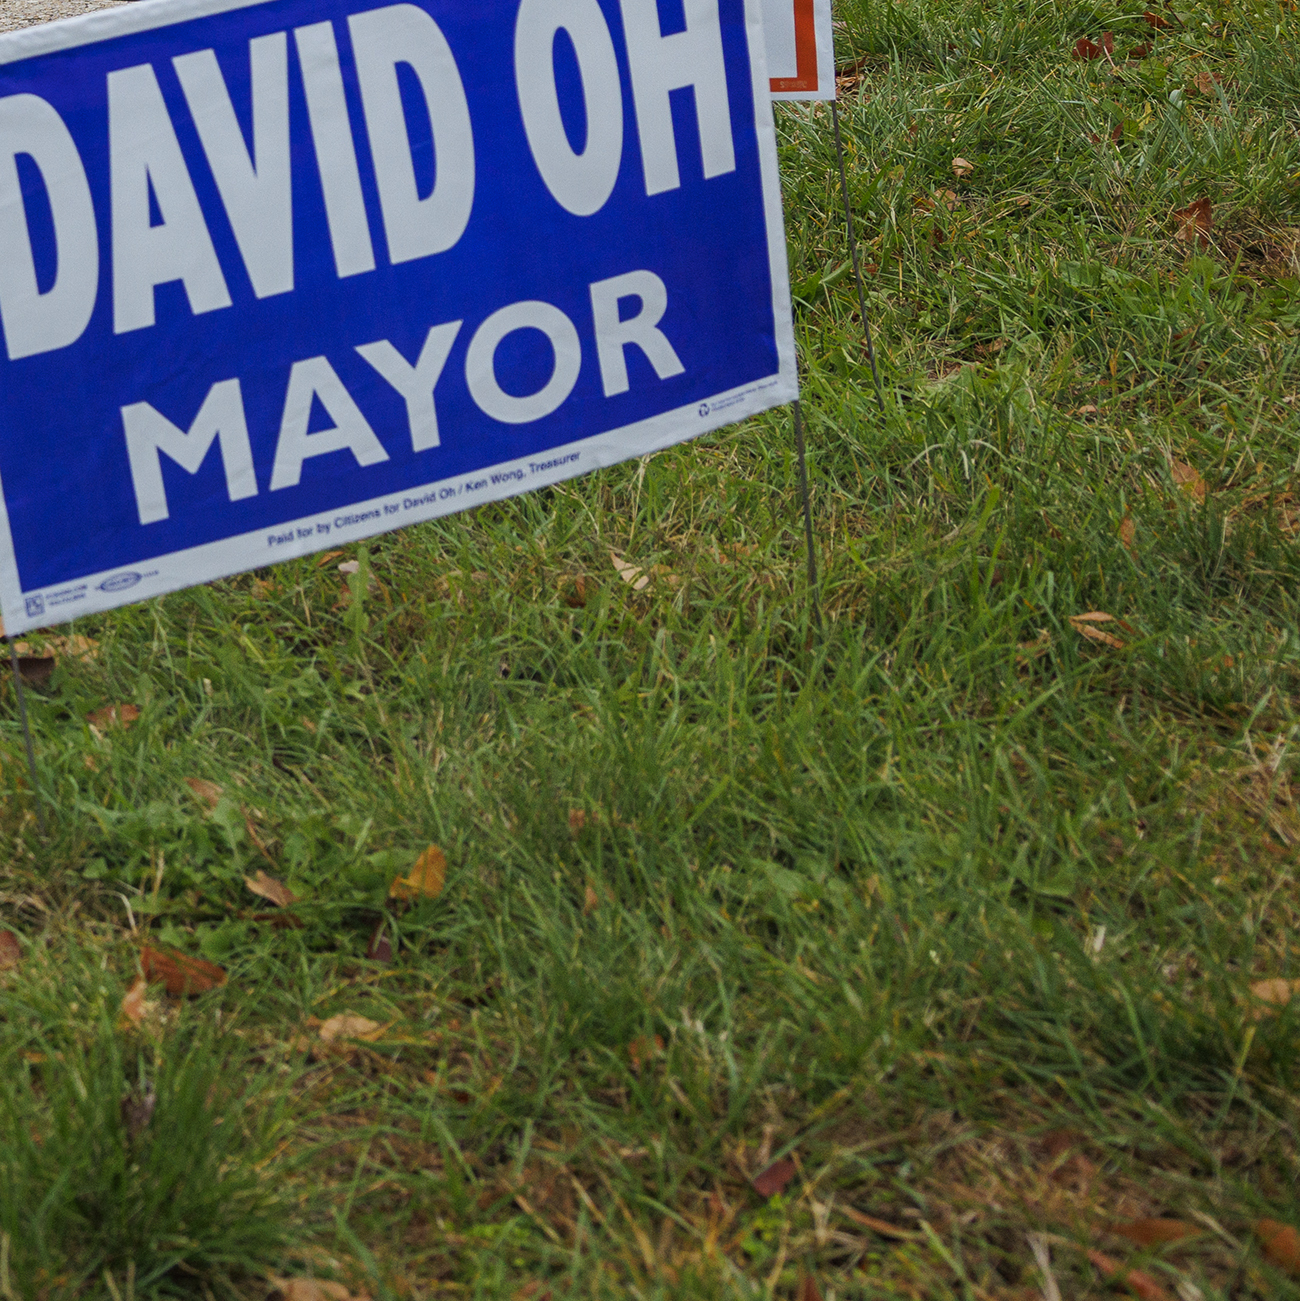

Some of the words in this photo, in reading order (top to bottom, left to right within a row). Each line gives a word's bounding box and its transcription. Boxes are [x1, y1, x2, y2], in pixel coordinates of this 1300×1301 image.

[120, 269, 687, 526] MAYOR
[267, 531, 295, 547] Paid
[296, 526, 314, 539] for
[316, 522, 332, 536] by
[333, 507, 381, 530] Citizens
[383, 502, 401, 516] for
[403, 492, 437, 511] David
[439, 486, 456, 501] Oh
[465, 478, 489, 494] Ken
[491, 468, 527, 487] Wong,
[528, 451, 582, 475] Treasurer
